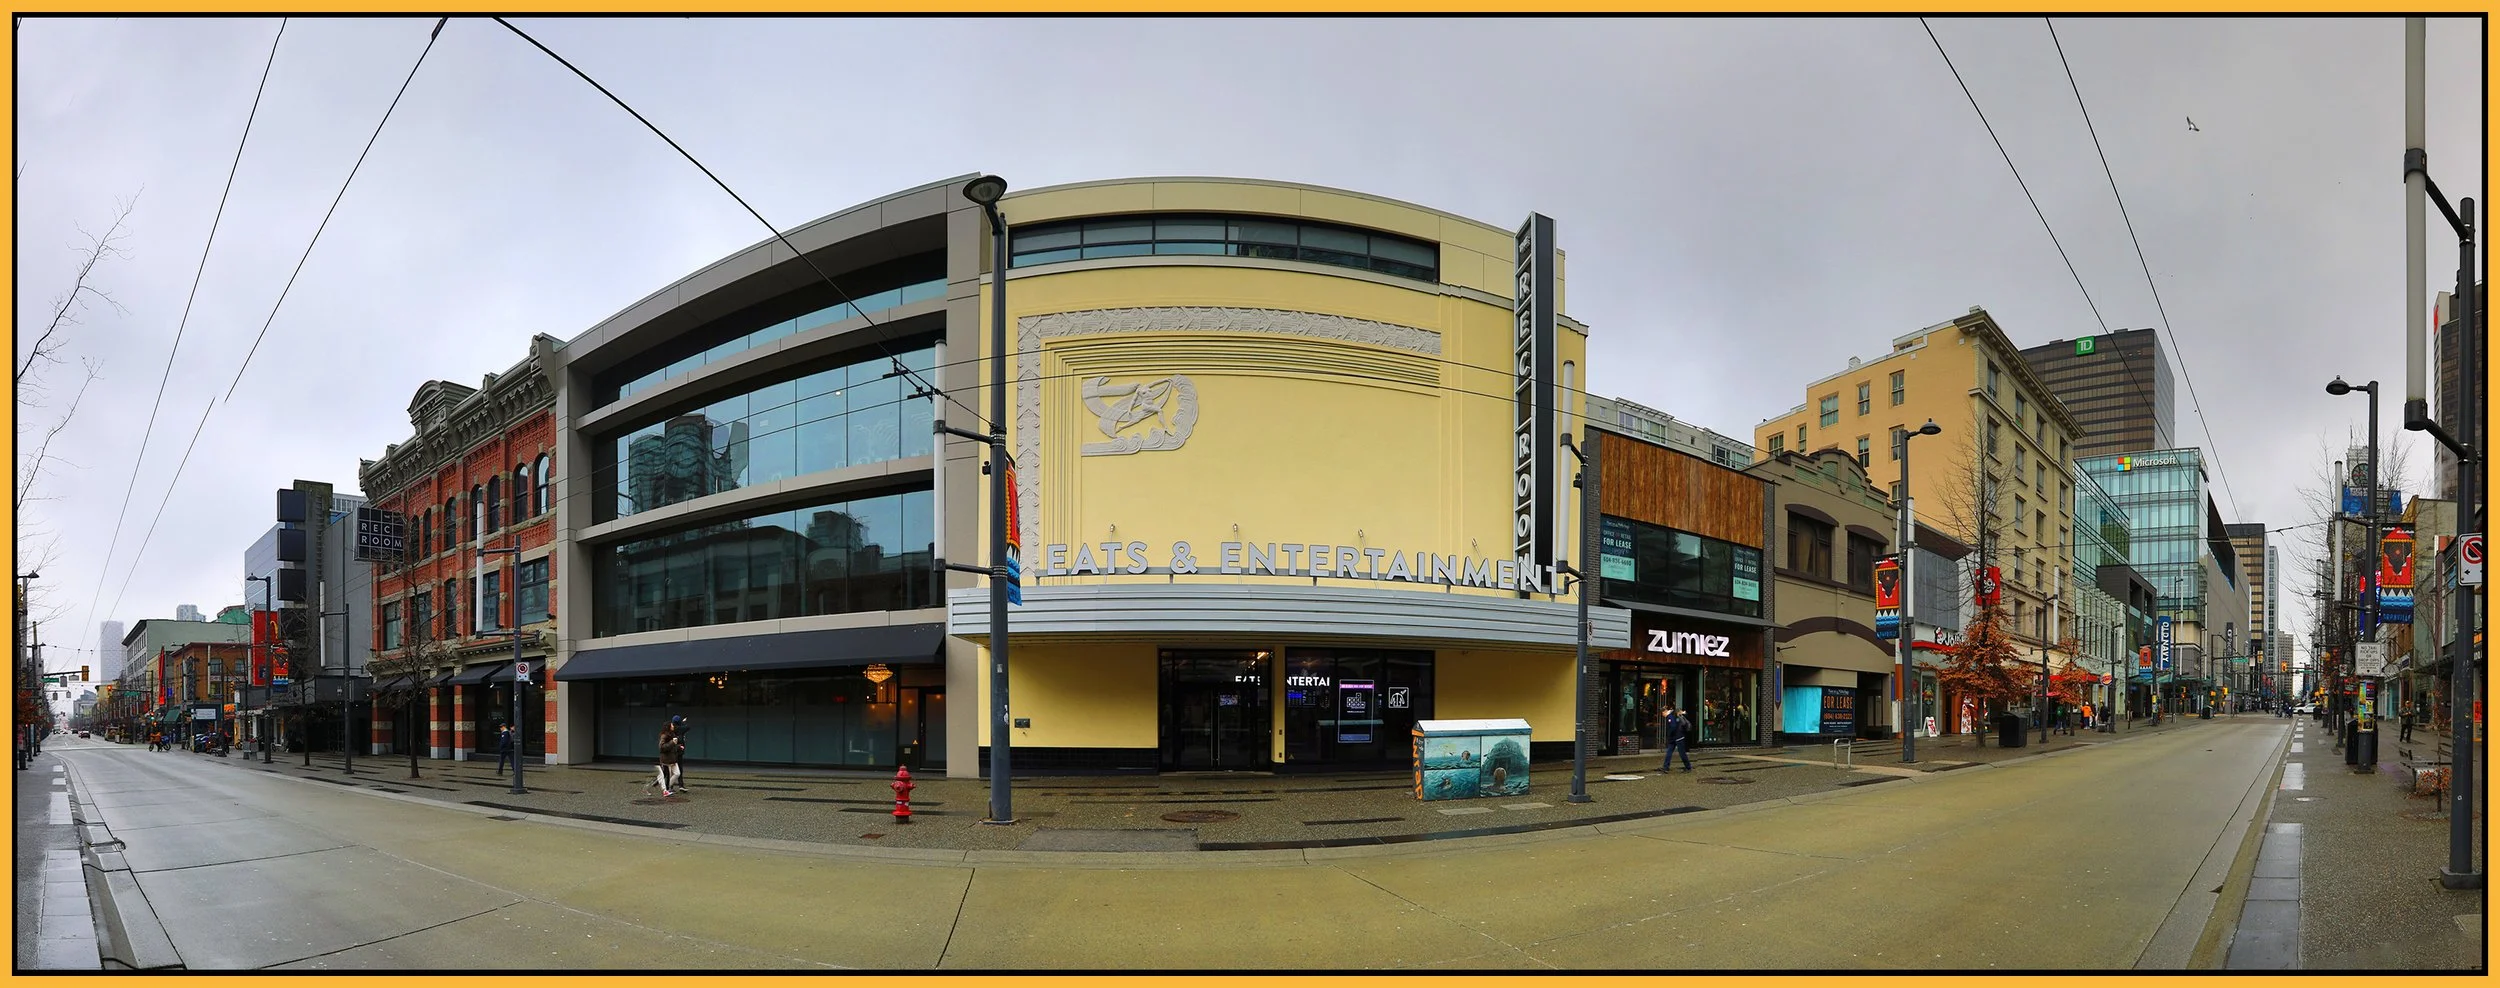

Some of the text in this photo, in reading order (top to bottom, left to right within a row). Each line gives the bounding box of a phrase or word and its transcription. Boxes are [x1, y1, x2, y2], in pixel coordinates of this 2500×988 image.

[1518, 271, 1531, 377] REC
[2077, 339, 2093, 352] TD
[2132, 454, 2177, 468] Microsoft
[361, 522, 391, 534] REC
[361, 535, 402, 548] ROOM
[1603, 537, 1632, 550] FOR LEASE
[1046, 541, 1558, 595] EATS & ENTERTAINMENT
[2162, 621, 2170, 663] OLD NAVY
[1823, 695, 1853, 710] FOR LEASE
